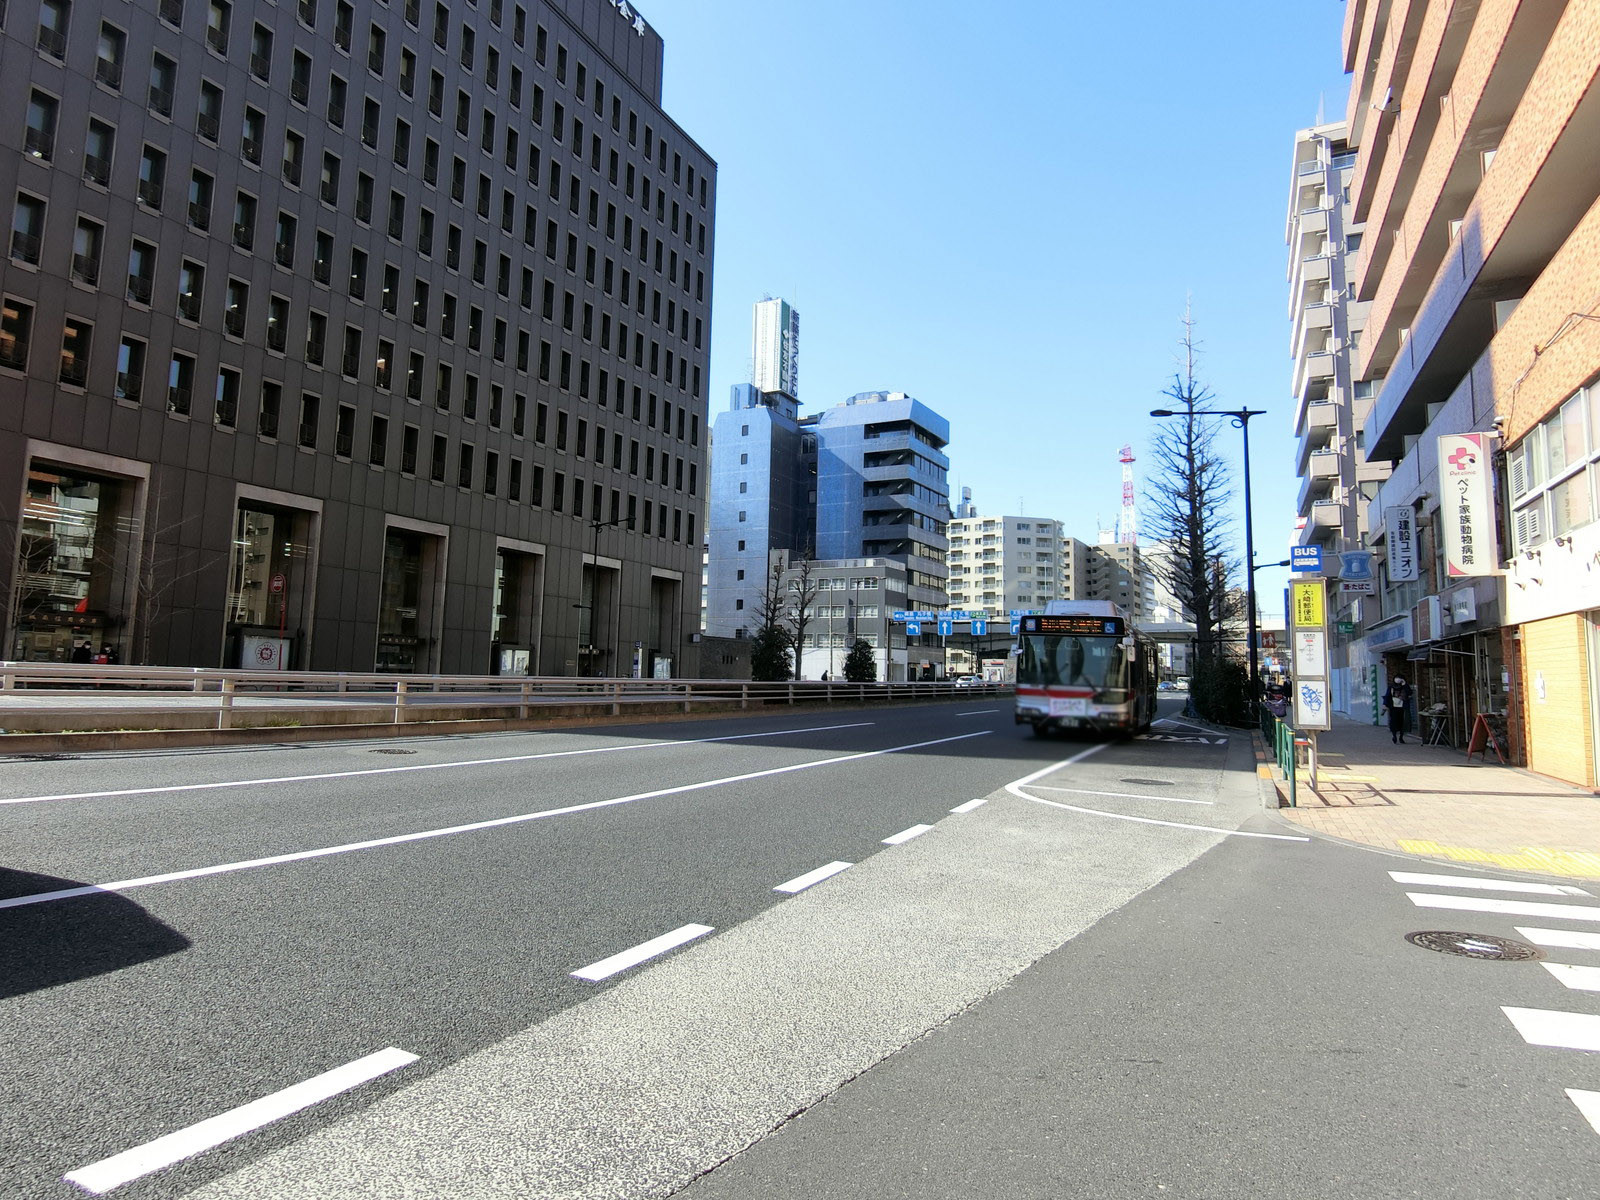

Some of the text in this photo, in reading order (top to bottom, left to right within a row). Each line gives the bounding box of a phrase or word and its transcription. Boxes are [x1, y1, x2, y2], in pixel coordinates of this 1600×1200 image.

[1457, 478, 1474, 565] ペット家族動物病院
[1294, 547, 1318, 556] BUS
[1398, 520, 1412, 578] 建設ユニオン
[1303, 590, 1312, 622] 大崎郵便局
